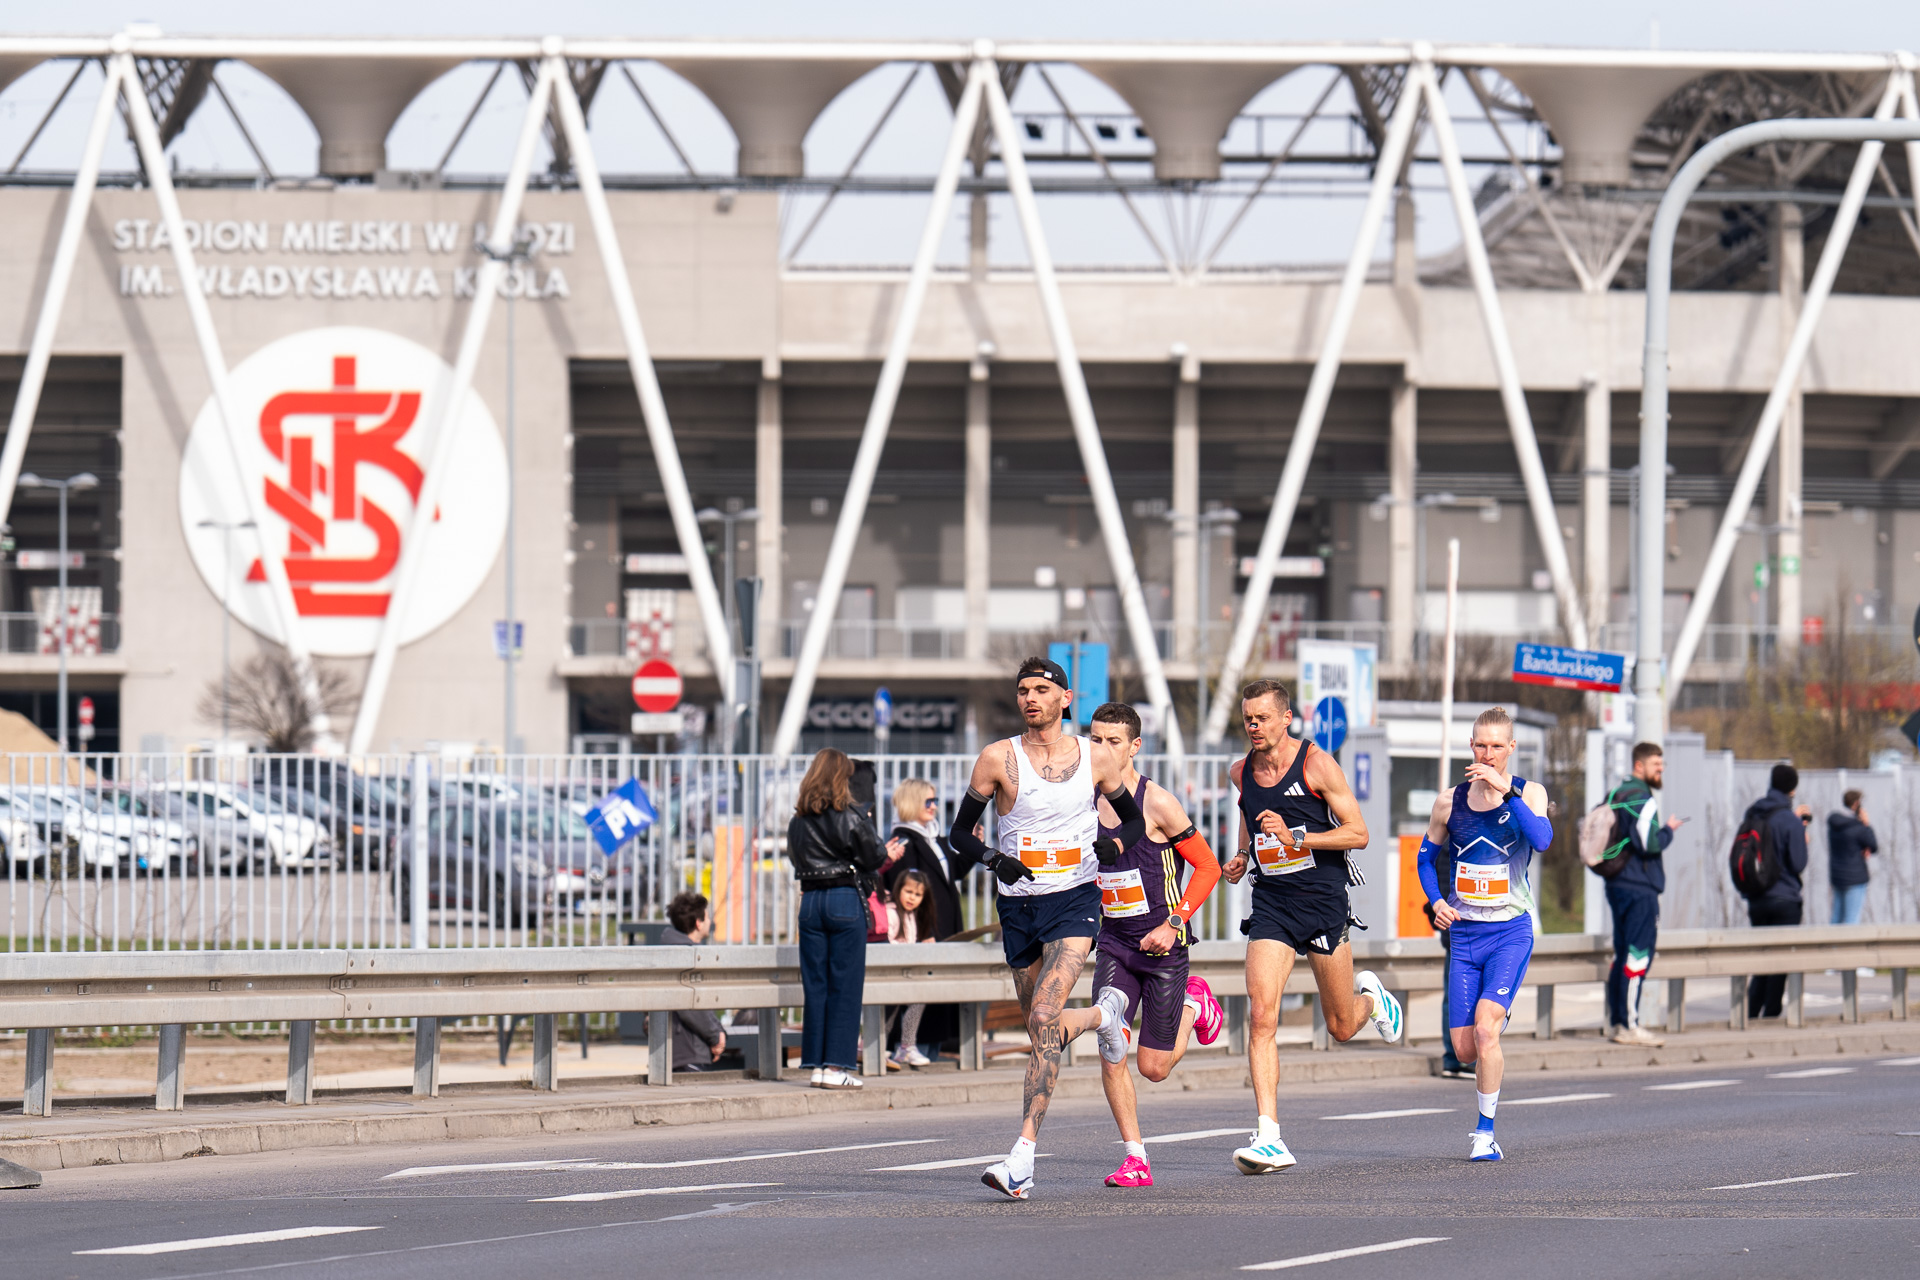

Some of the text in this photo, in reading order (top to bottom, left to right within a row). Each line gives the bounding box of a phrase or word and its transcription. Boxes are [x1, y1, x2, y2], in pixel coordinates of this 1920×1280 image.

[114, 219, 269, 252] STADION
[281, 220, 411, 252] MIEJSKI
[424, 221, 459, 252] W
[120, 265, 173, 296] IM.
[454, 257, 571, 299] KÓLA
[1522, 652, 1614, 683] Bandurskiego
[1046, 850, 1057, 864] 5
[1277, 846, 1287, 858] 4
[1474, 880, 1489, 892] 10
[1112, 889, 1119, 901] 1
